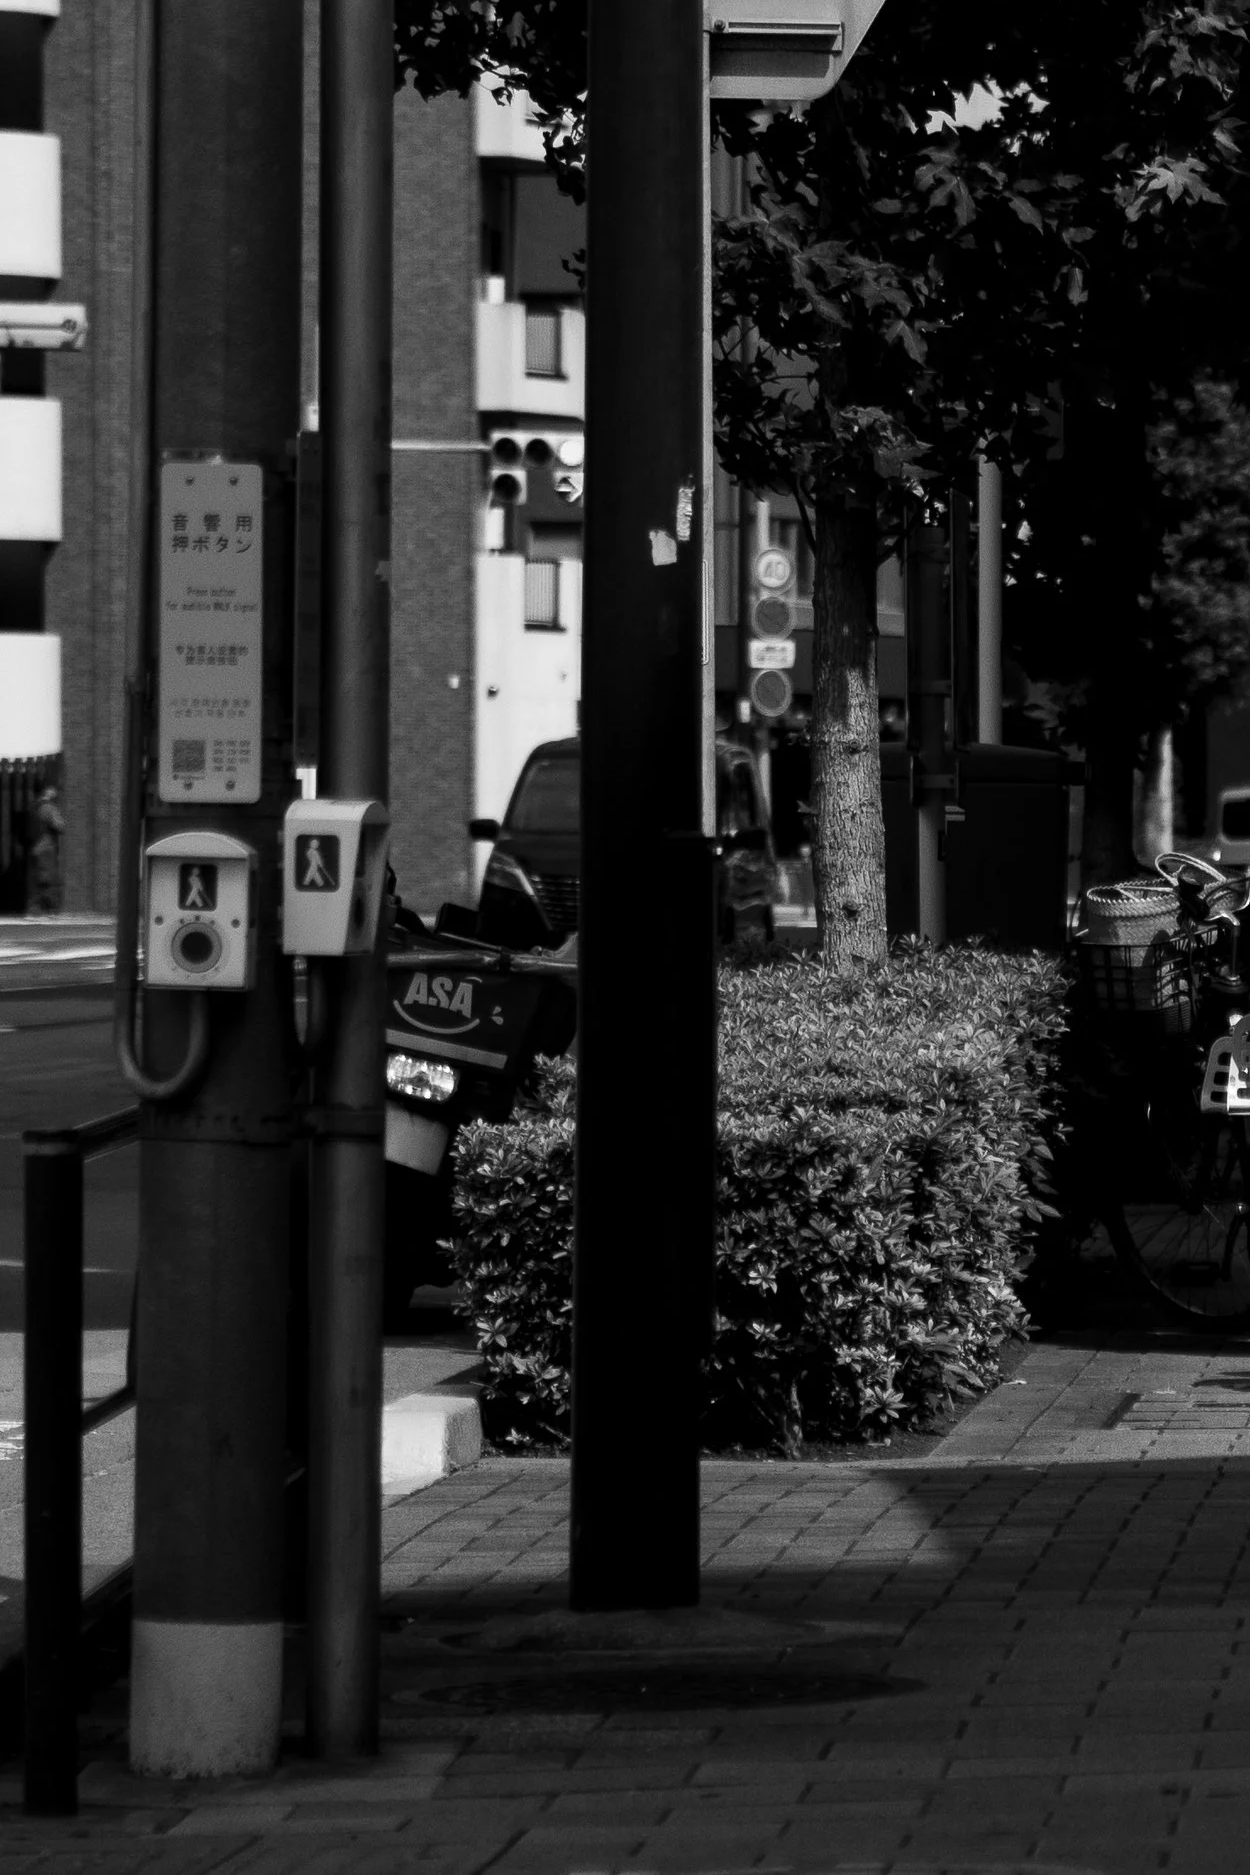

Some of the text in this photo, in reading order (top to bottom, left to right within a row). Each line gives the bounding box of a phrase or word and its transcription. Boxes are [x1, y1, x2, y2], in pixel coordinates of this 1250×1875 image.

[172, 513, 253, 533] 音響用
[172, 535, 252, 553] 押ボタン
